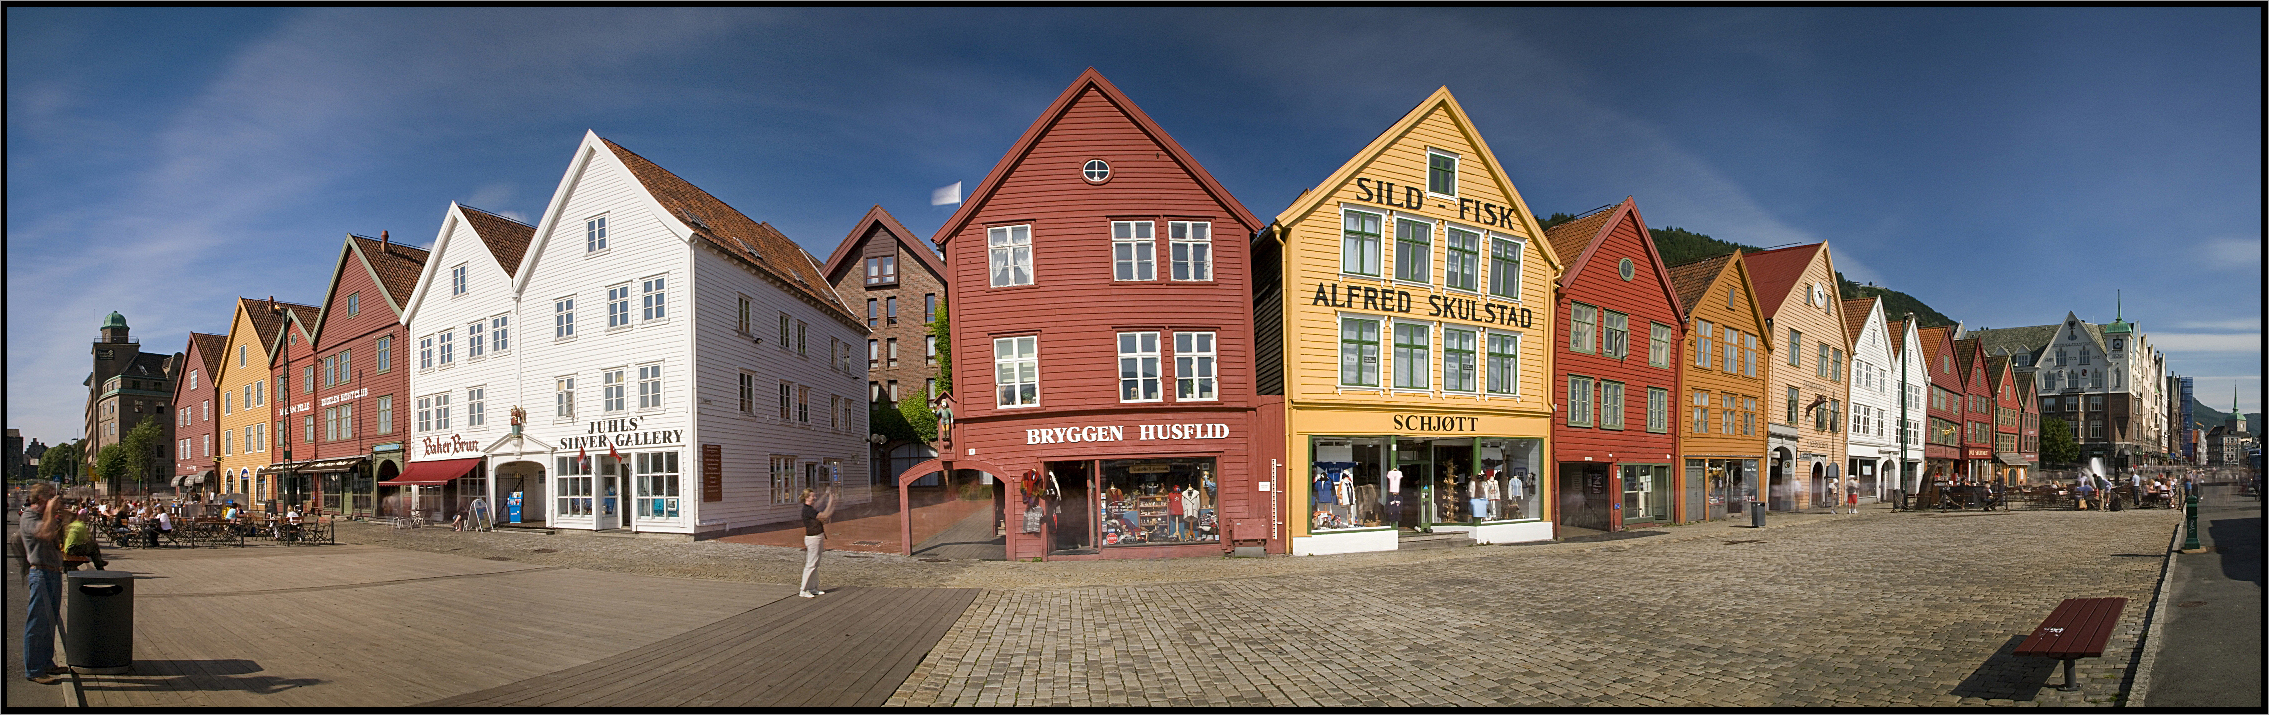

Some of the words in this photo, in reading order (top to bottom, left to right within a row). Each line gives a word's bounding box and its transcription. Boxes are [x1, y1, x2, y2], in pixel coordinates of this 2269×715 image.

[1356, 177, 1423, 210] SILD
[1459, 197, 1515, 230] FISK
[1312, 282, 1411, 313] ALFRED
[1428, 294, 1532, 328] SKULSTAD
[1026, 425, 1124, 445] BRYGGEN
[1139, 423, 1230, 441] HUSFLID
[1393, 414, 1479, 432] SCHJØTT
[422, 435, 451, 458] Baker
[450, 433, 479, 456] Brun
[559, 434, 607, 450] SILVER
[615, 429, 683, 447] GALLERY
